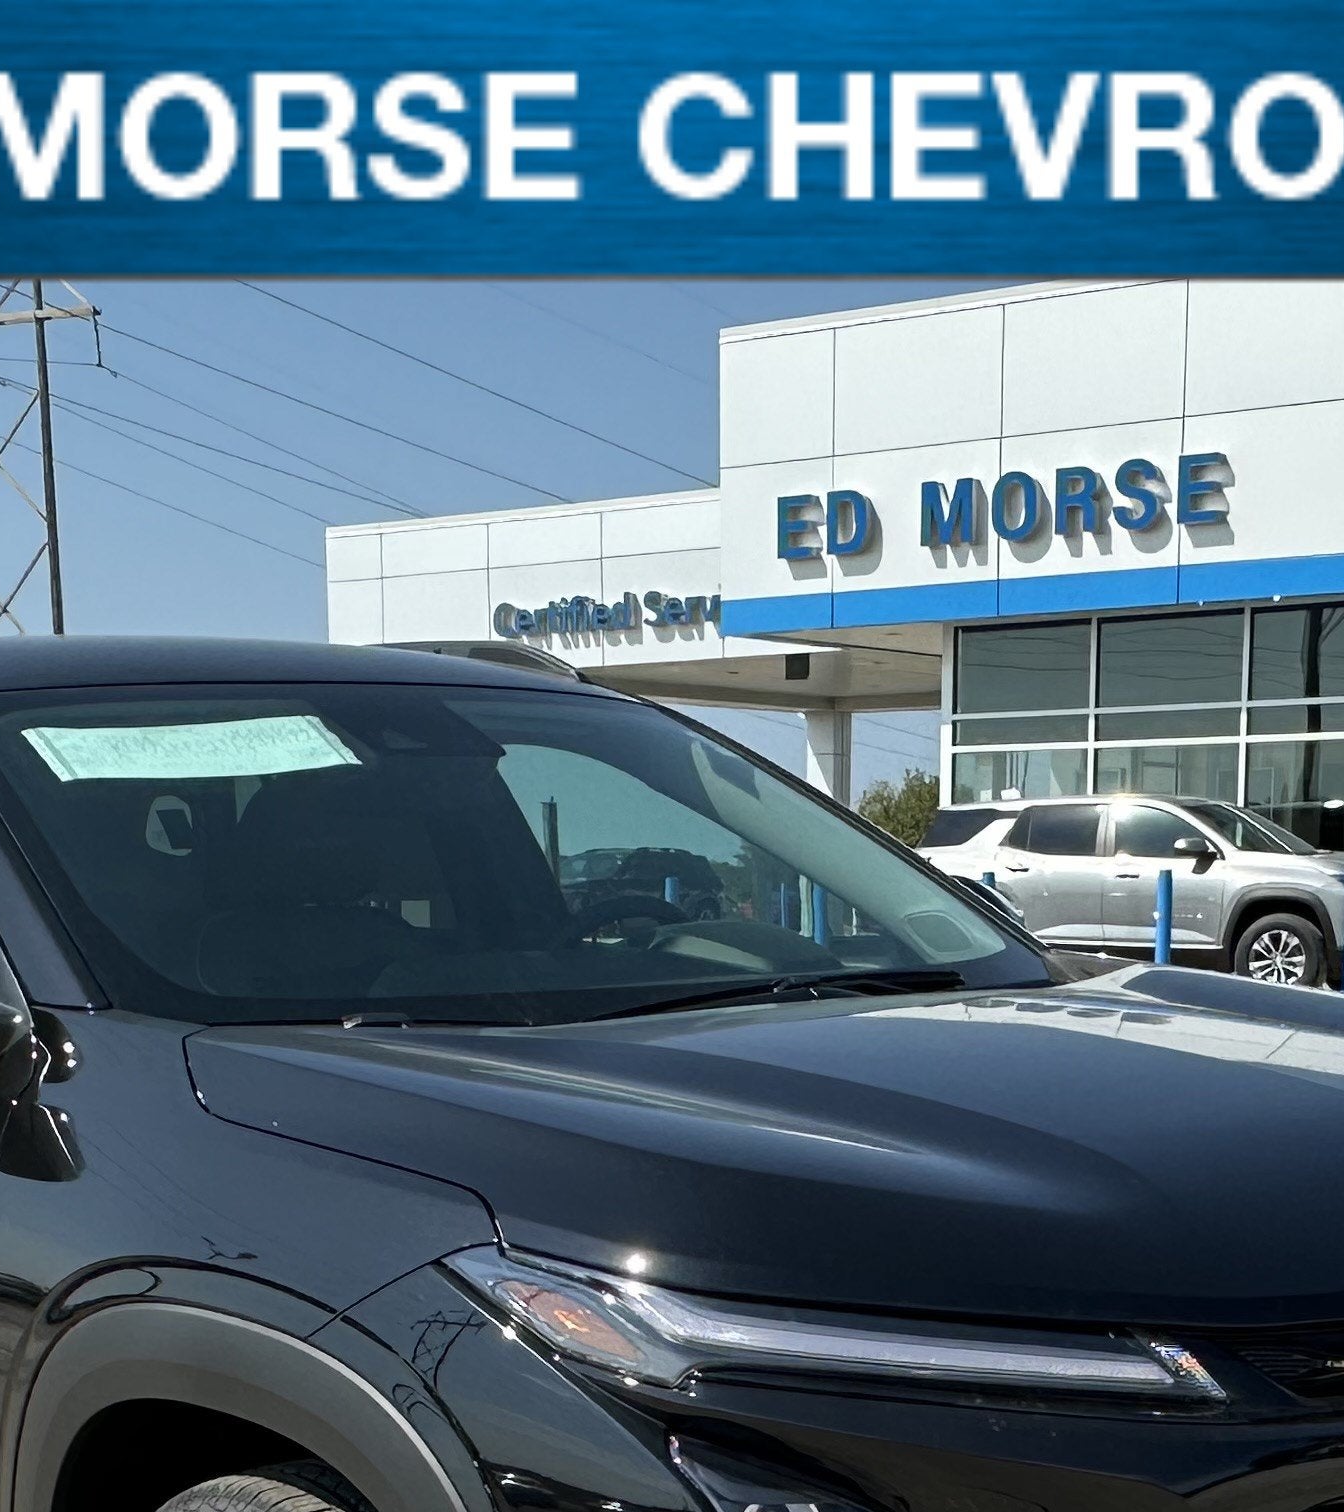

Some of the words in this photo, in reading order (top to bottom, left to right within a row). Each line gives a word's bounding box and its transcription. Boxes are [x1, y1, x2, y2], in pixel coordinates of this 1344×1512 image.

[776, 488, 872, 561] ED
[919, 451, 1232, 548] MORSE
[493, 591, 640, 639] Certified
